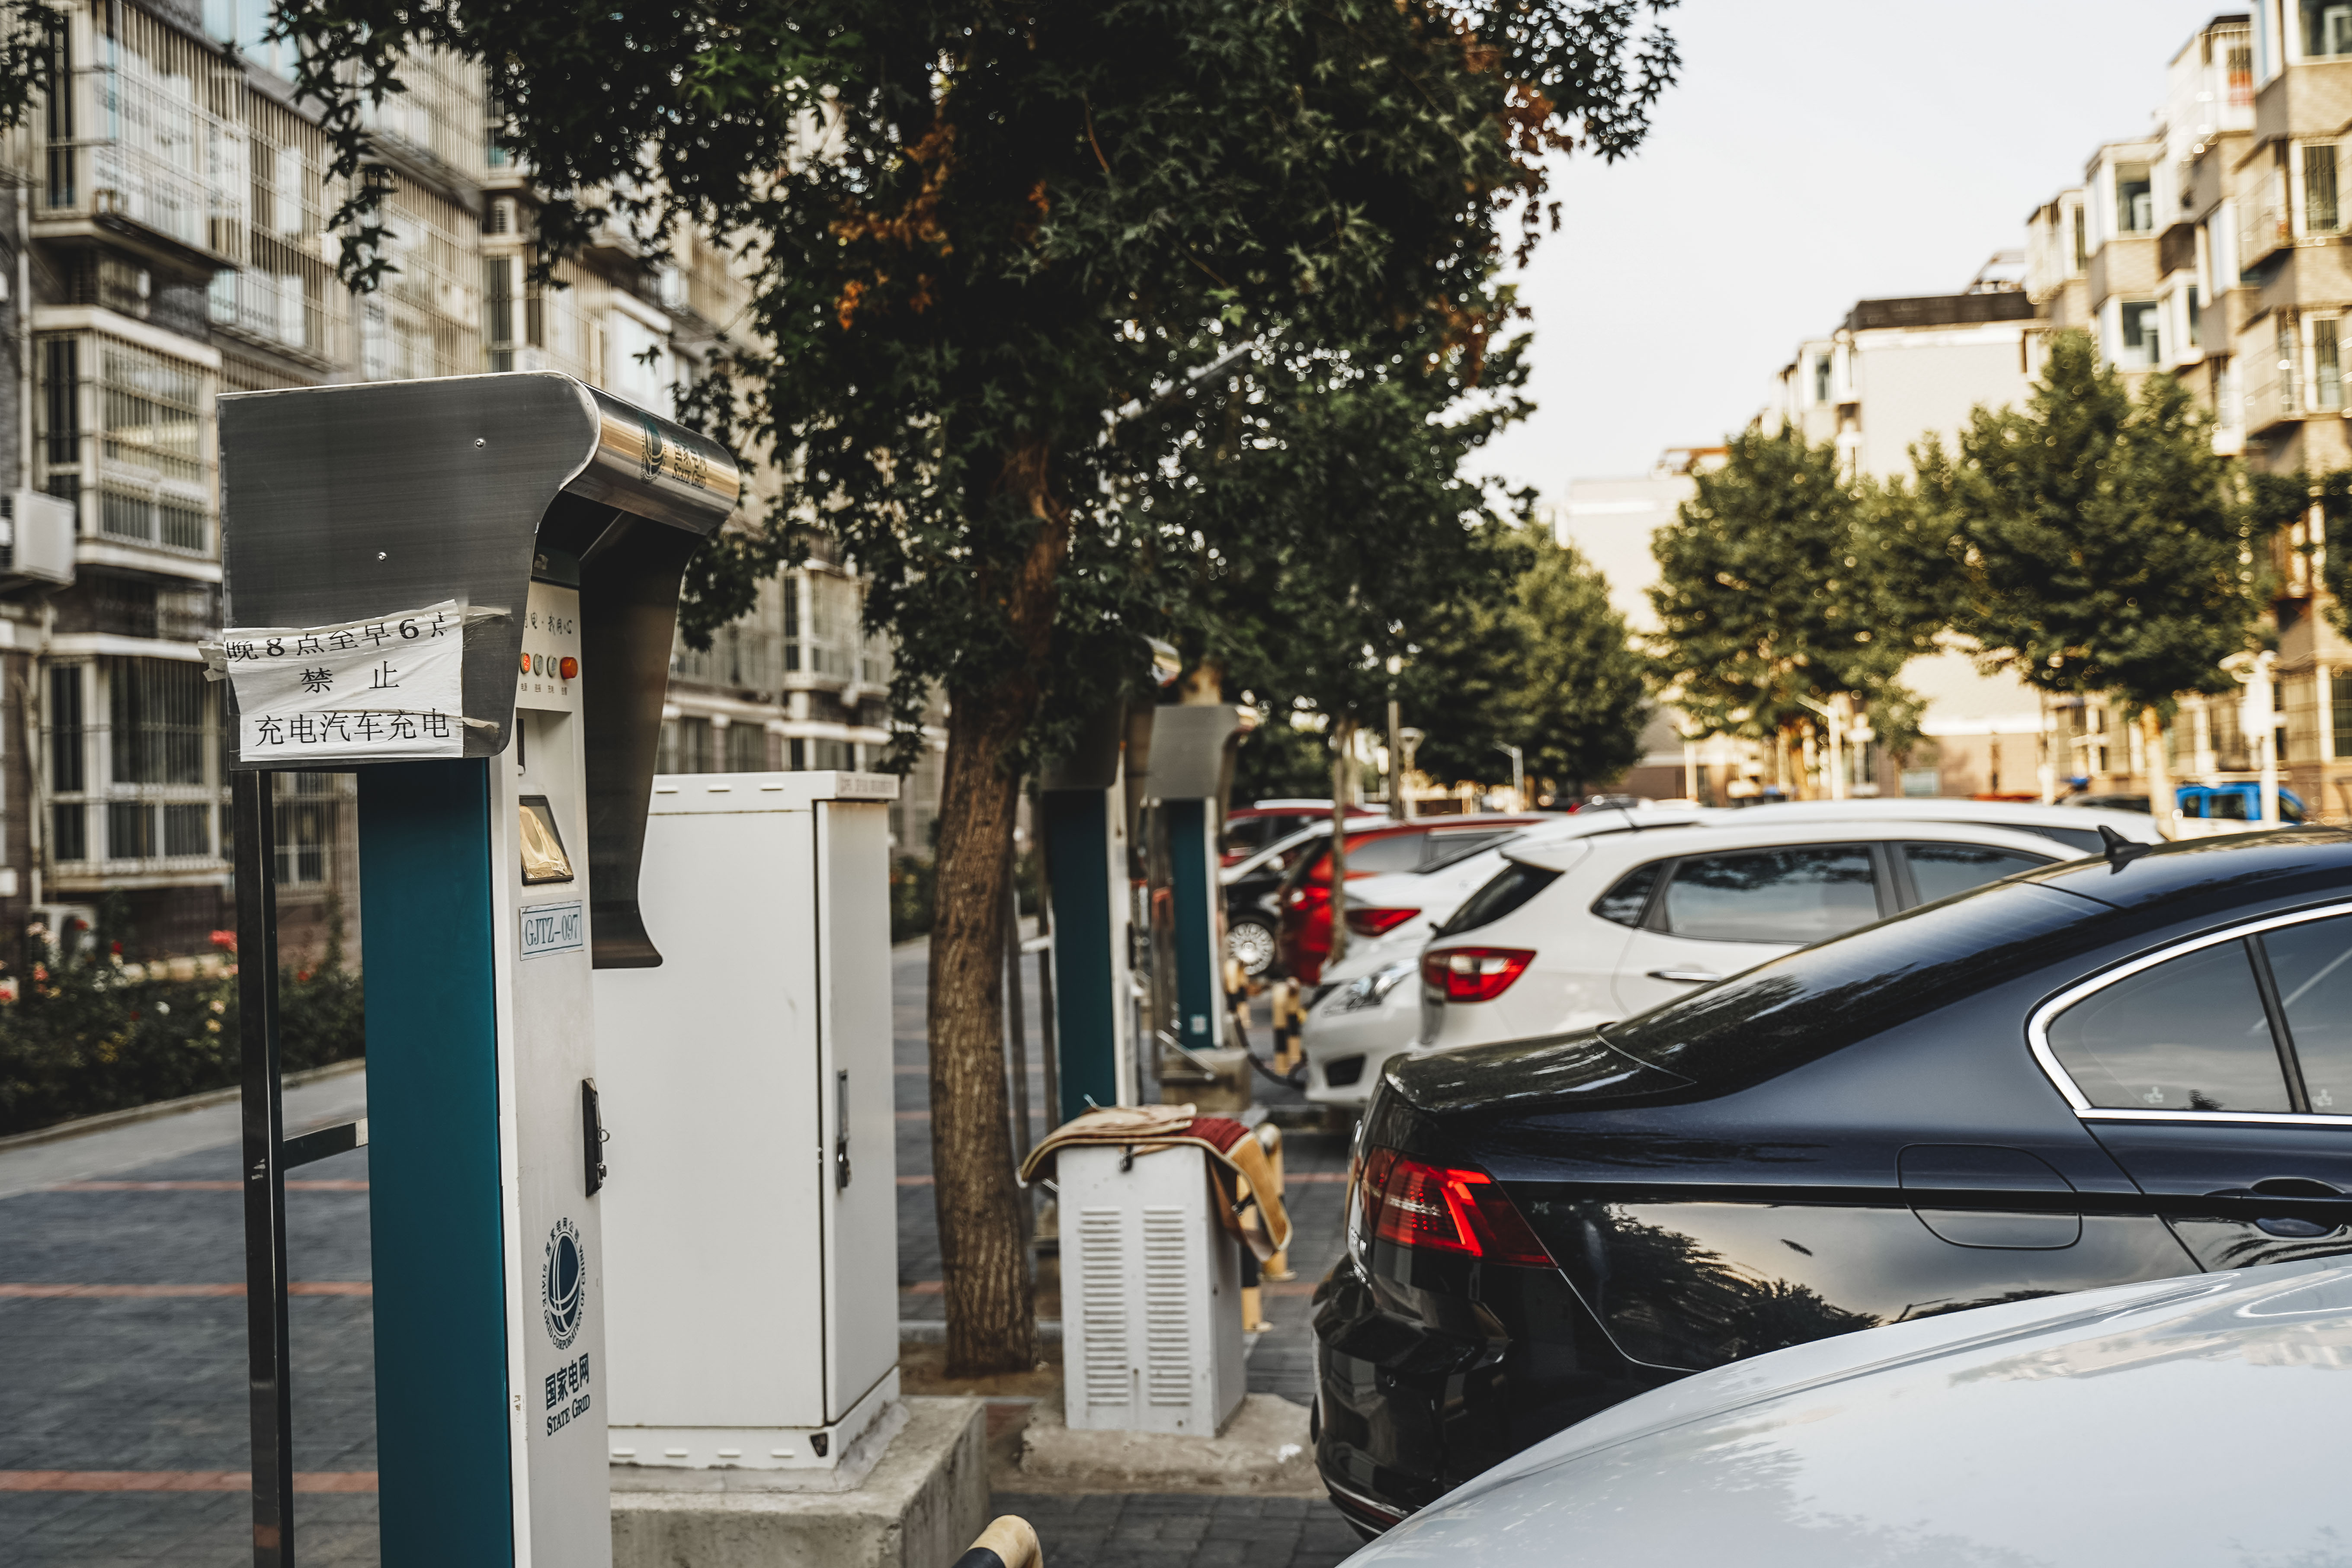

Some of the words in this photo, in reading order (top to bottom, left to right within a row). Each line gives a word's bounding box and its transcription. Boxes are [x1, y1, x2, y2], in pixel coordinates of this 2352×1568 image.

[226, 611, 447, 663] 晚8点至早6点
[255, 708, 450, 747] 充电汽车充电
[525, 914, 578, 946] GJTZ-097
[545, 1352, 590, 1411] 国家电网
[547, 1407, 570, 1437] STATE
[572, 1393, 590, 1419] GRID
